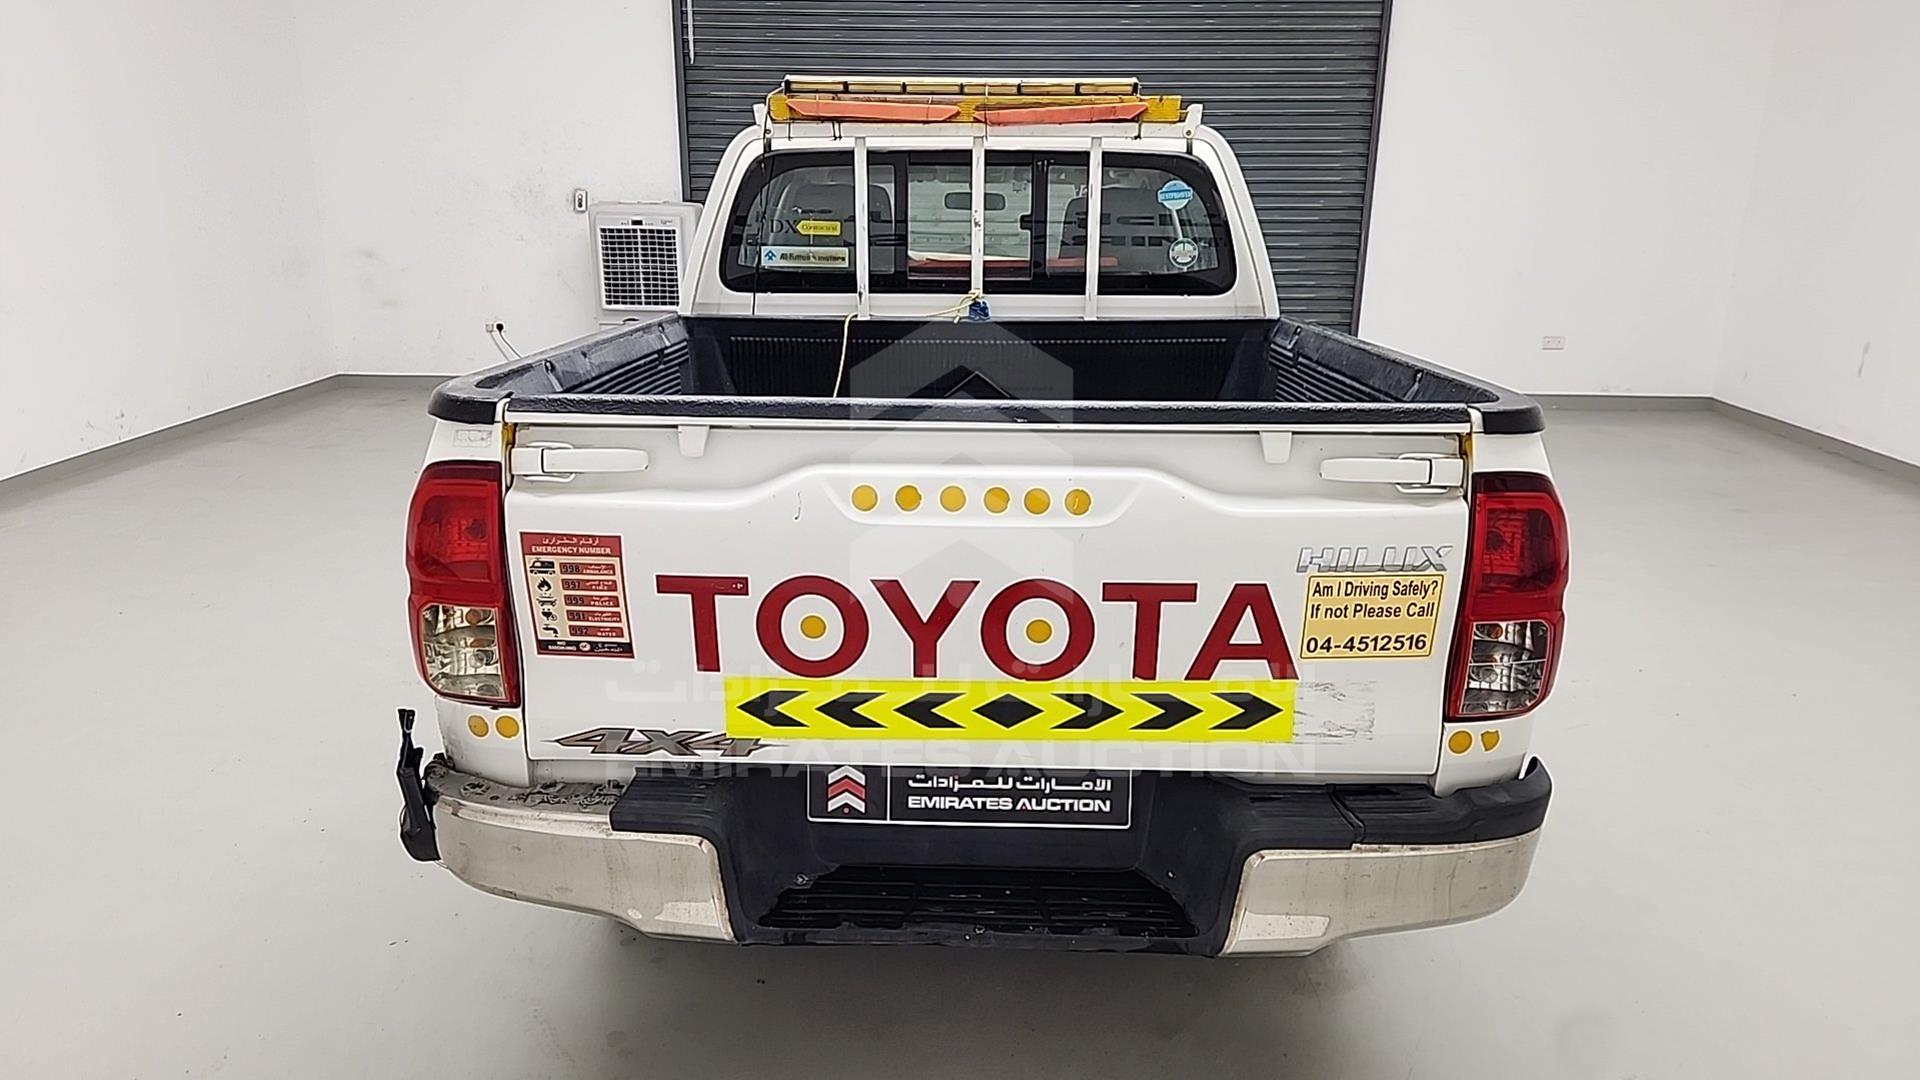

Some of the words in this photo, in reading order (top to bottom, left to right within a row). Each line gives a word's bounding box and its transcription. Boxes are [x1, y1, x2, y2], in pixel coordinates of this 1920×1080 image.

[770, 220, 797, 234] DX
[532, 545, 577, 554] EMERGENCY
[562, 564, 581, 573] 998
[1296, 546, 1453, 573] HILUX
[1312, 581, 1333, 597] Am
[1337, 581, 1341, 597] I
[1345, 580, 1389, 600] Driving
[1392, 580, 1438, 600] Safely?
[1310, 604, 1321, 619] If
[1324, 604, 1349, 619] not
[1353, 602, 1401, 619] Please
[1406, 602, 1435, 617] Call
[656, 574, 1299, 682] TOYOTA
[1306, 634, 1427, 653] 04-4512516
[907, 795, 1013, 811] EMIRATES
[1015, 797, 1111, 813] AUCTION
